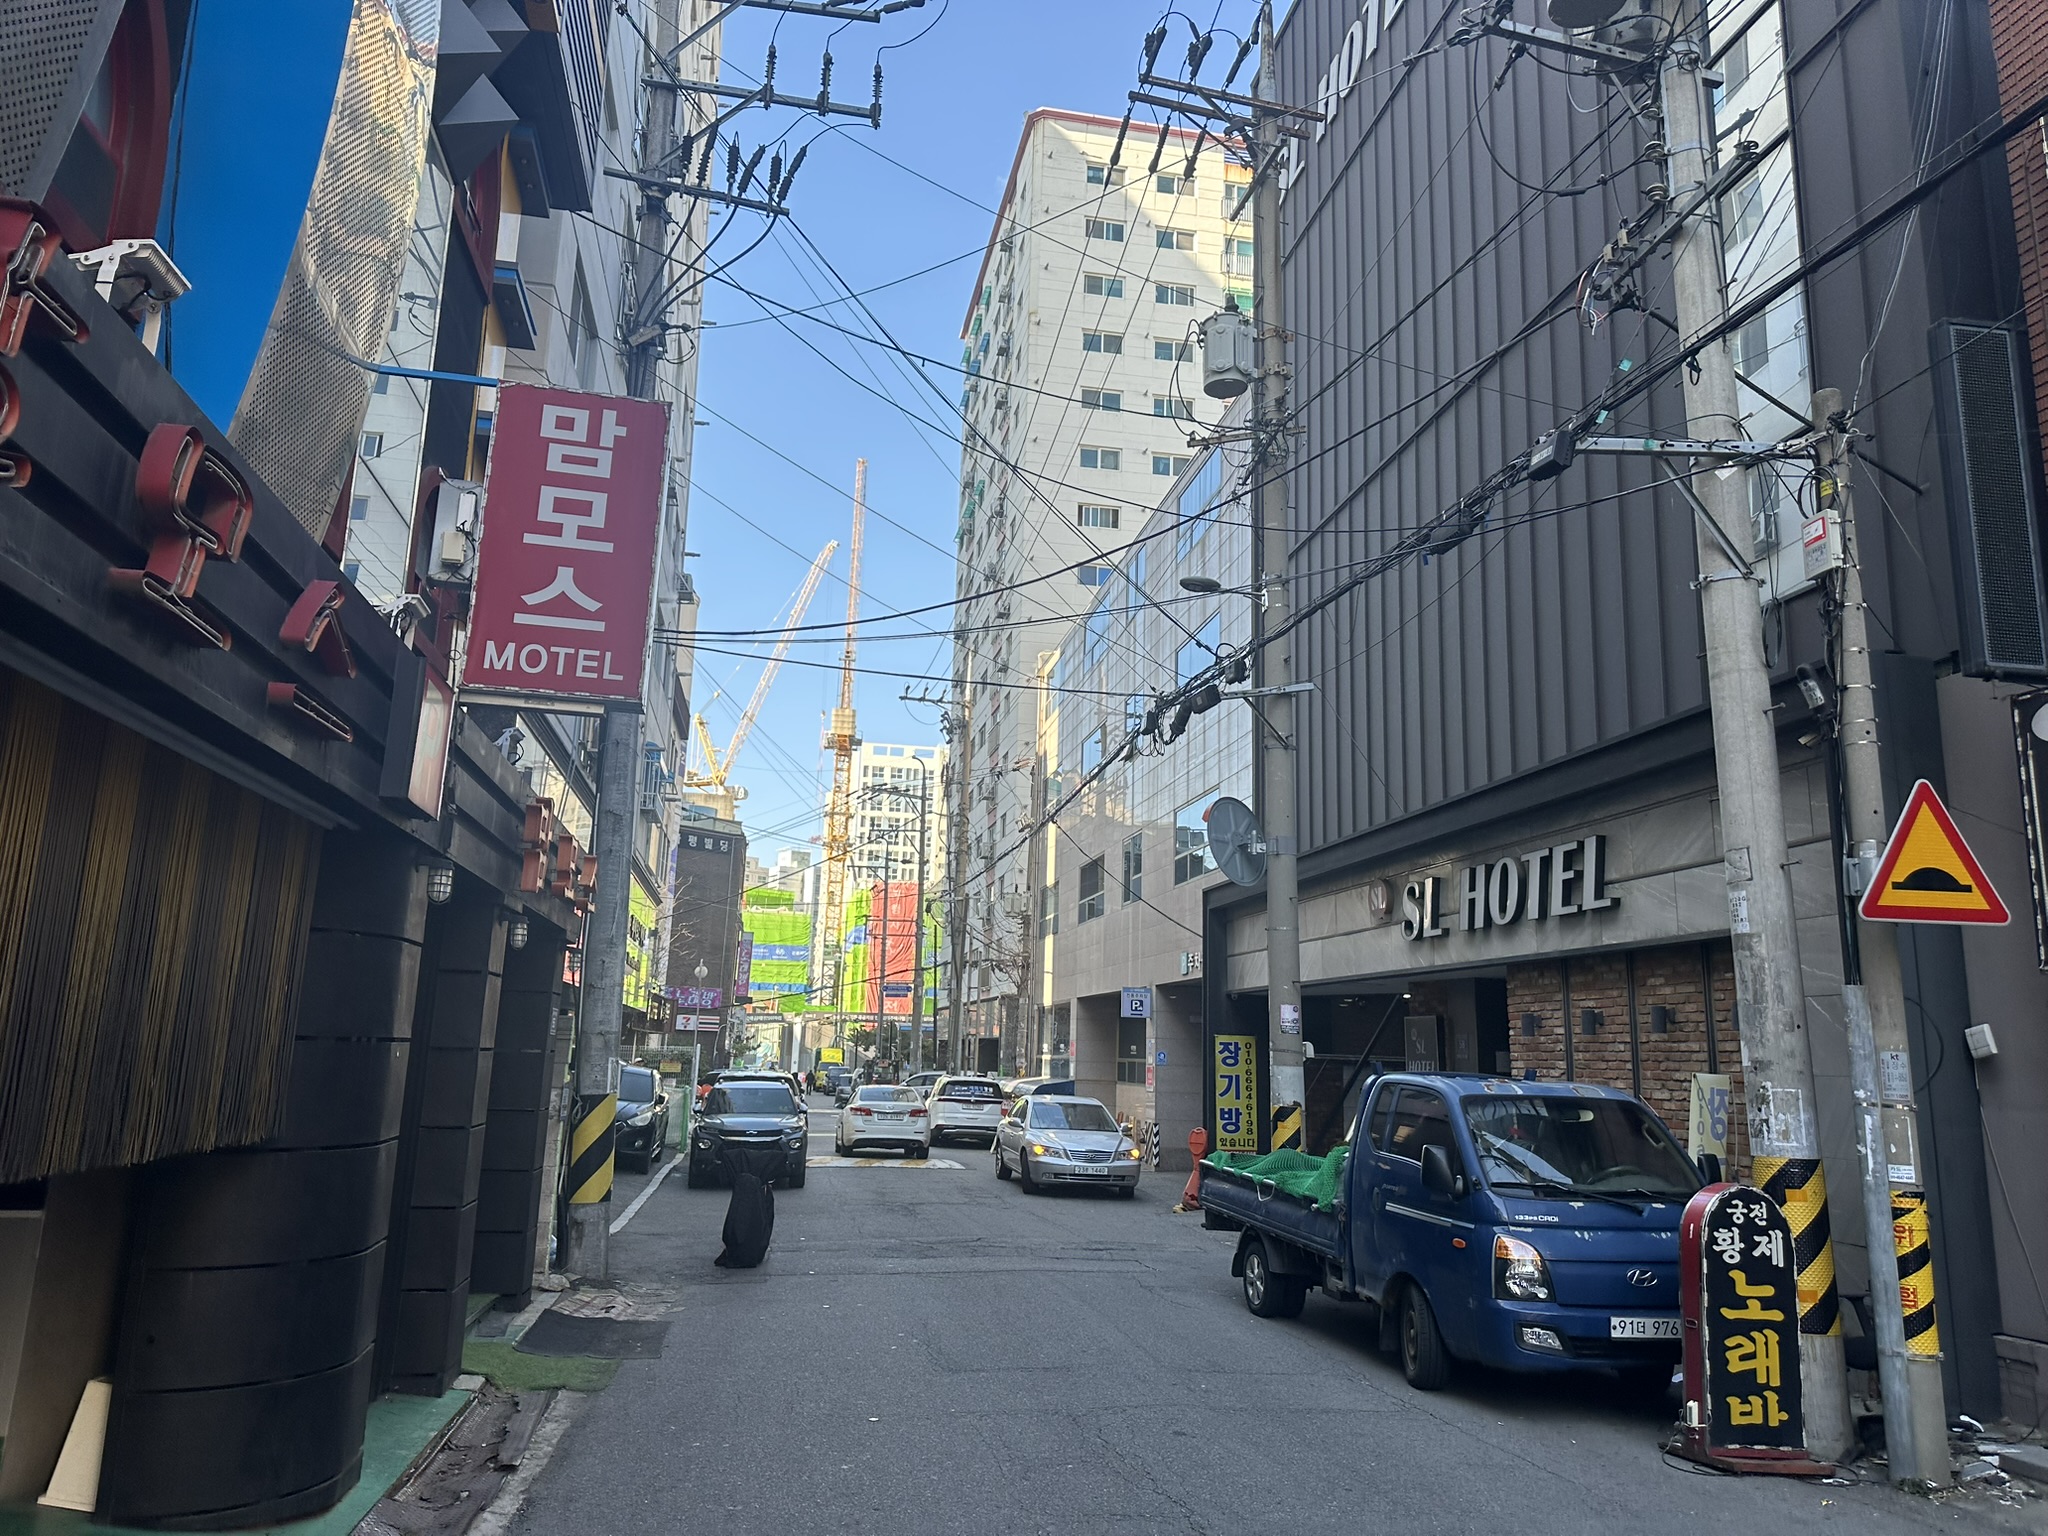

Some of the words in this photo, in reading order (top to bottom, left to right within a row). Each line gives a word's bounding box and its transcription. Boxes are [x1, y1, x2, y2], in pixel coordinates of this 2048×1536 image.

[513, 404, 627, 632] 맘모스
[482, 640, 624, 681] MOTEL
[678, 832, 729, 853] 평빌딩
[1401, 876, 1449, 942] SL
[1459, 834, 1621, 932] HOTEL
[1889, 1053, 1900, 1061] kt
[1217, 1041, 1242, 1135] 장기방
[1219, 1137, 1256, 1149] 있습니다
[1725, 1200, 1768, 1226] 궁전
[1712, 1227, 1785, 1268] 황제
[1652, 1320, 1682, 1337] 976
[1719, 1268, 1790, 1428] 노래바
